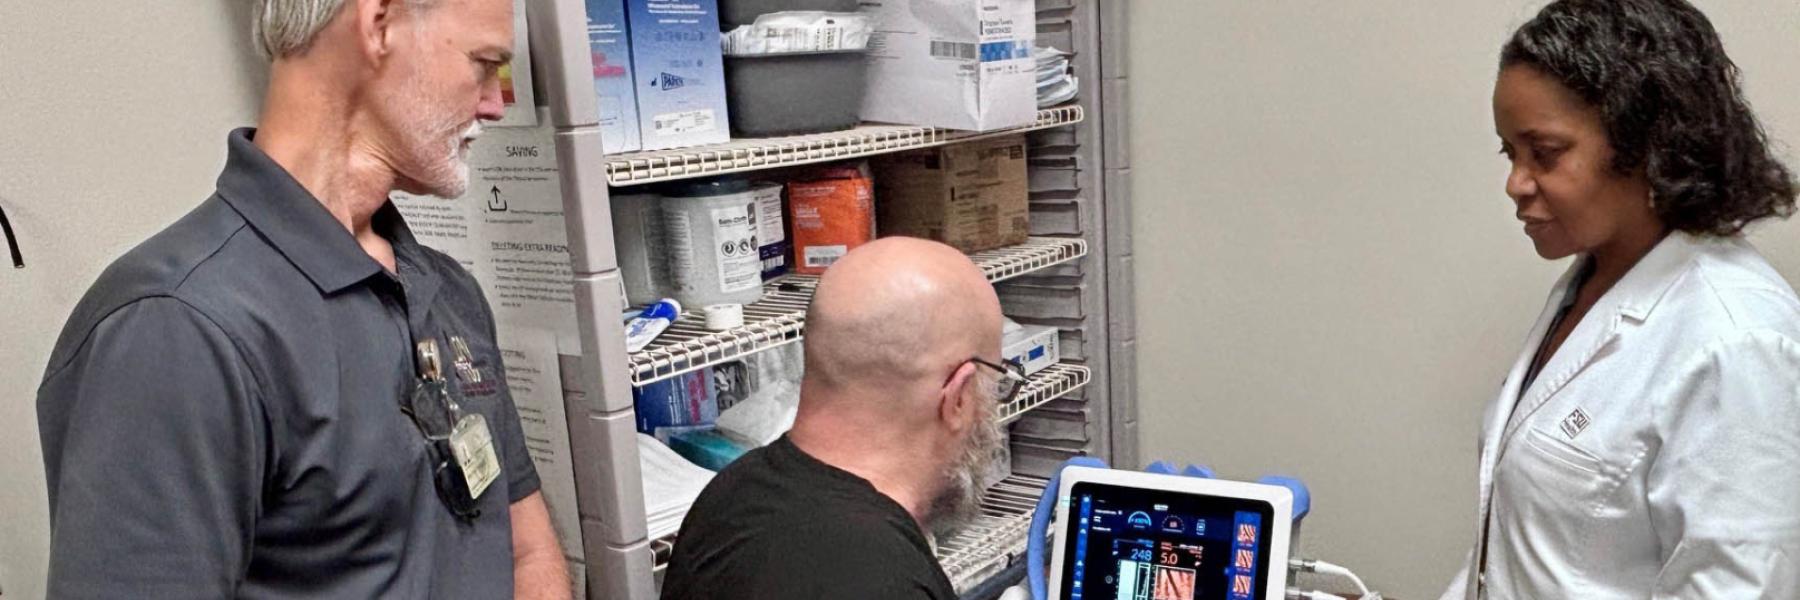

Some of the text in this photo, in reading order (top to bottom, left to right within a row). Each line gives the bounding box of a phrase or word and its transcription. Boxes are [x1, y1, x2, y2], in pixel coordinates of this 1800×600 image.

[506, 146, 538, 157] SAVING
[1568, 409, 1587, 429] FSU
[1131, 548, 1178, 565] 248 5.0
